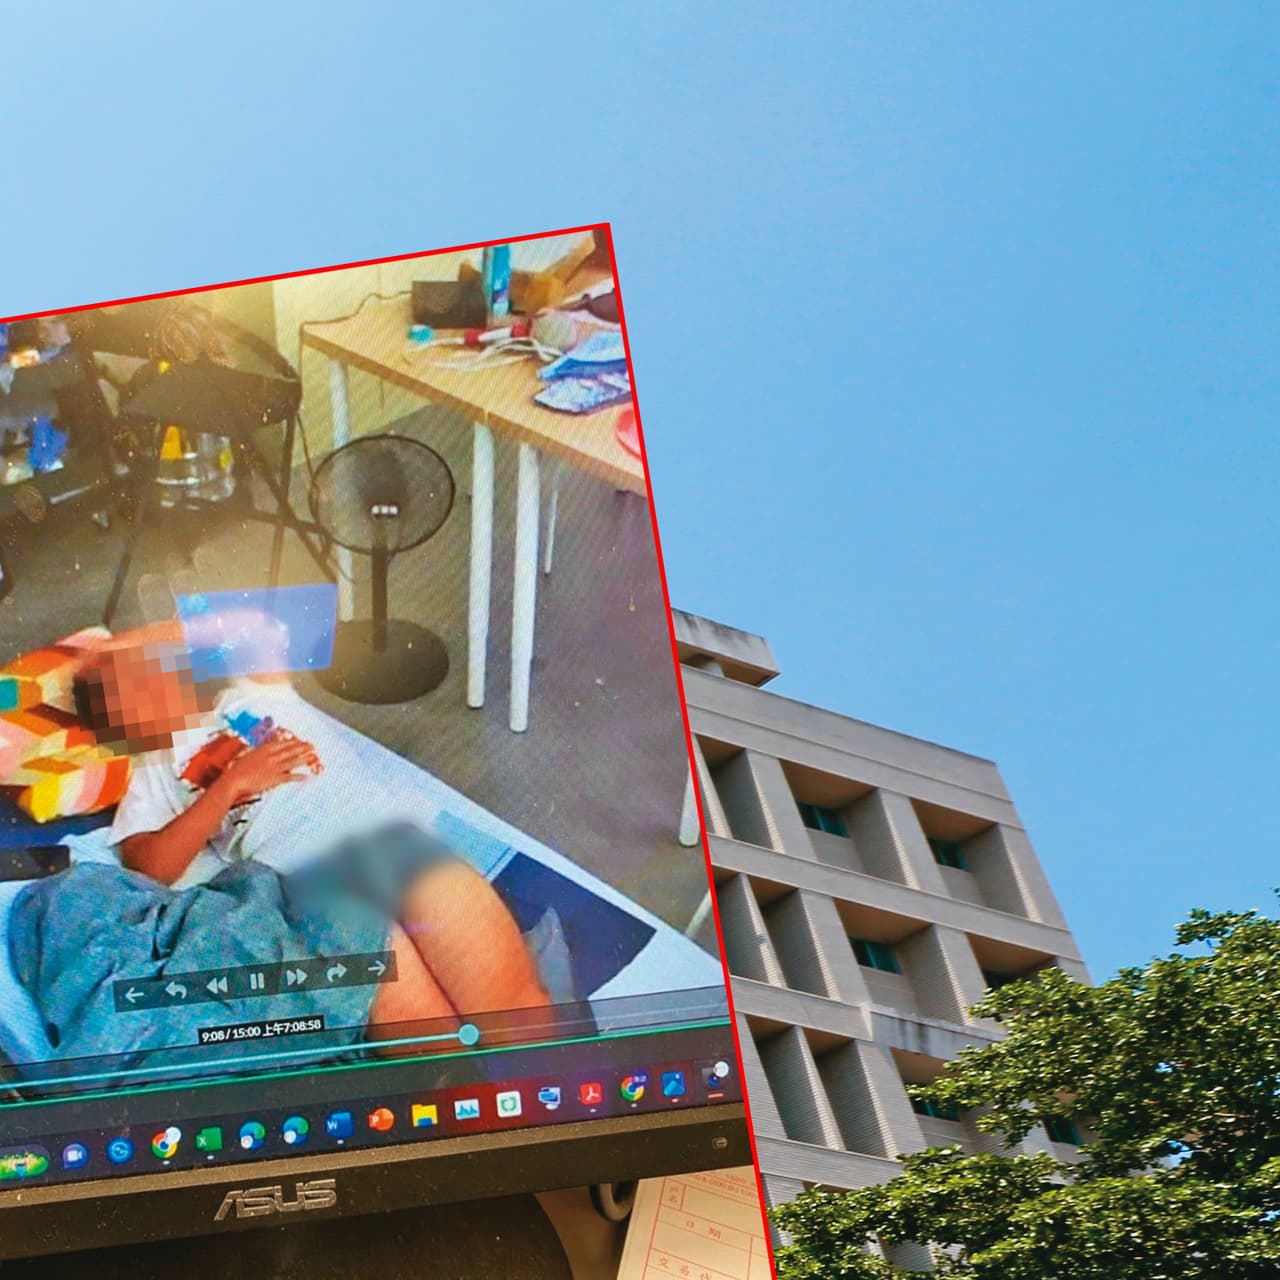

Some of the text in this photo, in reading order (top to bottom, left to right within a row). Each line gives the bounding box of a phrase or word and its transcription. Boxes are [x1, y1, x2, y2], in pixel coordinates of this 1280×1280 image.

[202, 1030, 225, 1042] 9:08
[233, 1026, 261, 1039] 15:00
[213, 1179, 338, 1221] ASUS
